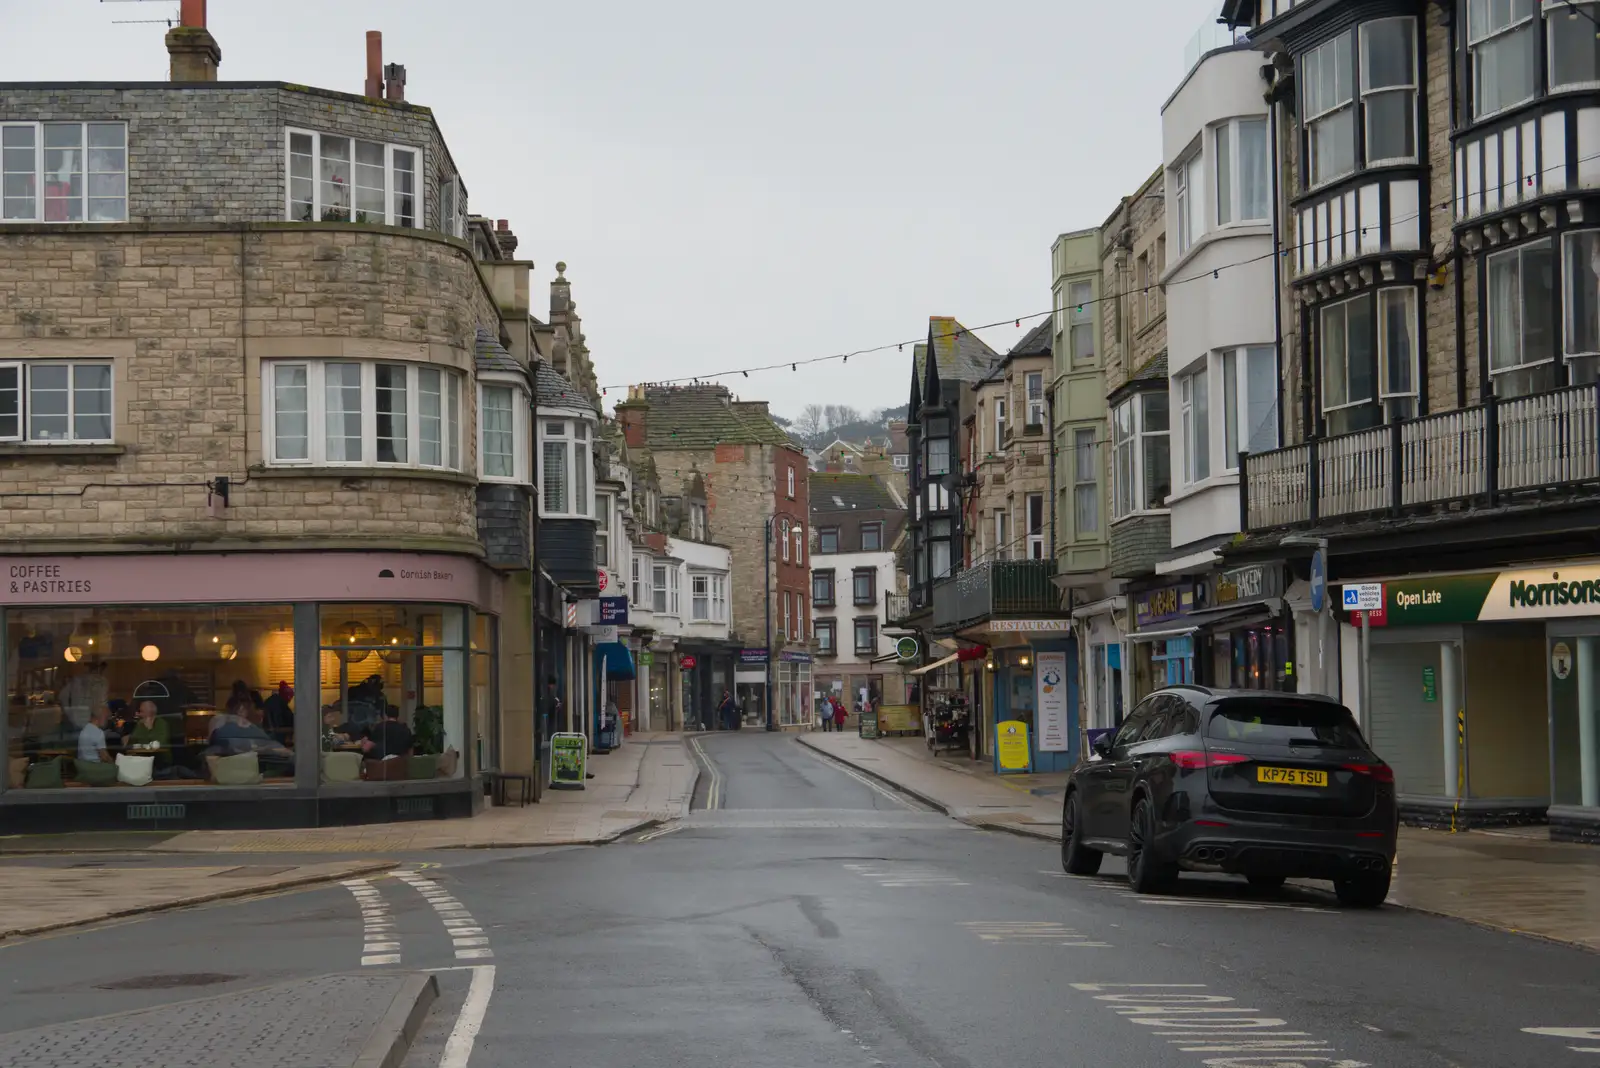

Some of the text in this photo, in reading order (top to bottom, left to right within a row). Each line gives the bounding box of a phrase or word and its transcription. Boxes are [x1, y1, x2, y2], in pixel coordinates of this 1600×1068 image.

[9, 565, 61, 578] COFFEE
[400, 569, 454, 582] Cornish Bakery
[9, 580, 92, 593] & PASTRIES
[1236, 567, 1263, 598] BAKERY
[1509, 571, 1600, 608] Morrisons
[1396, 589, 1442, 610] Open Late
[991, 620, 1069, 630] RESTAURANT
[1262, 768, 1323, 784] KP75 TSU
